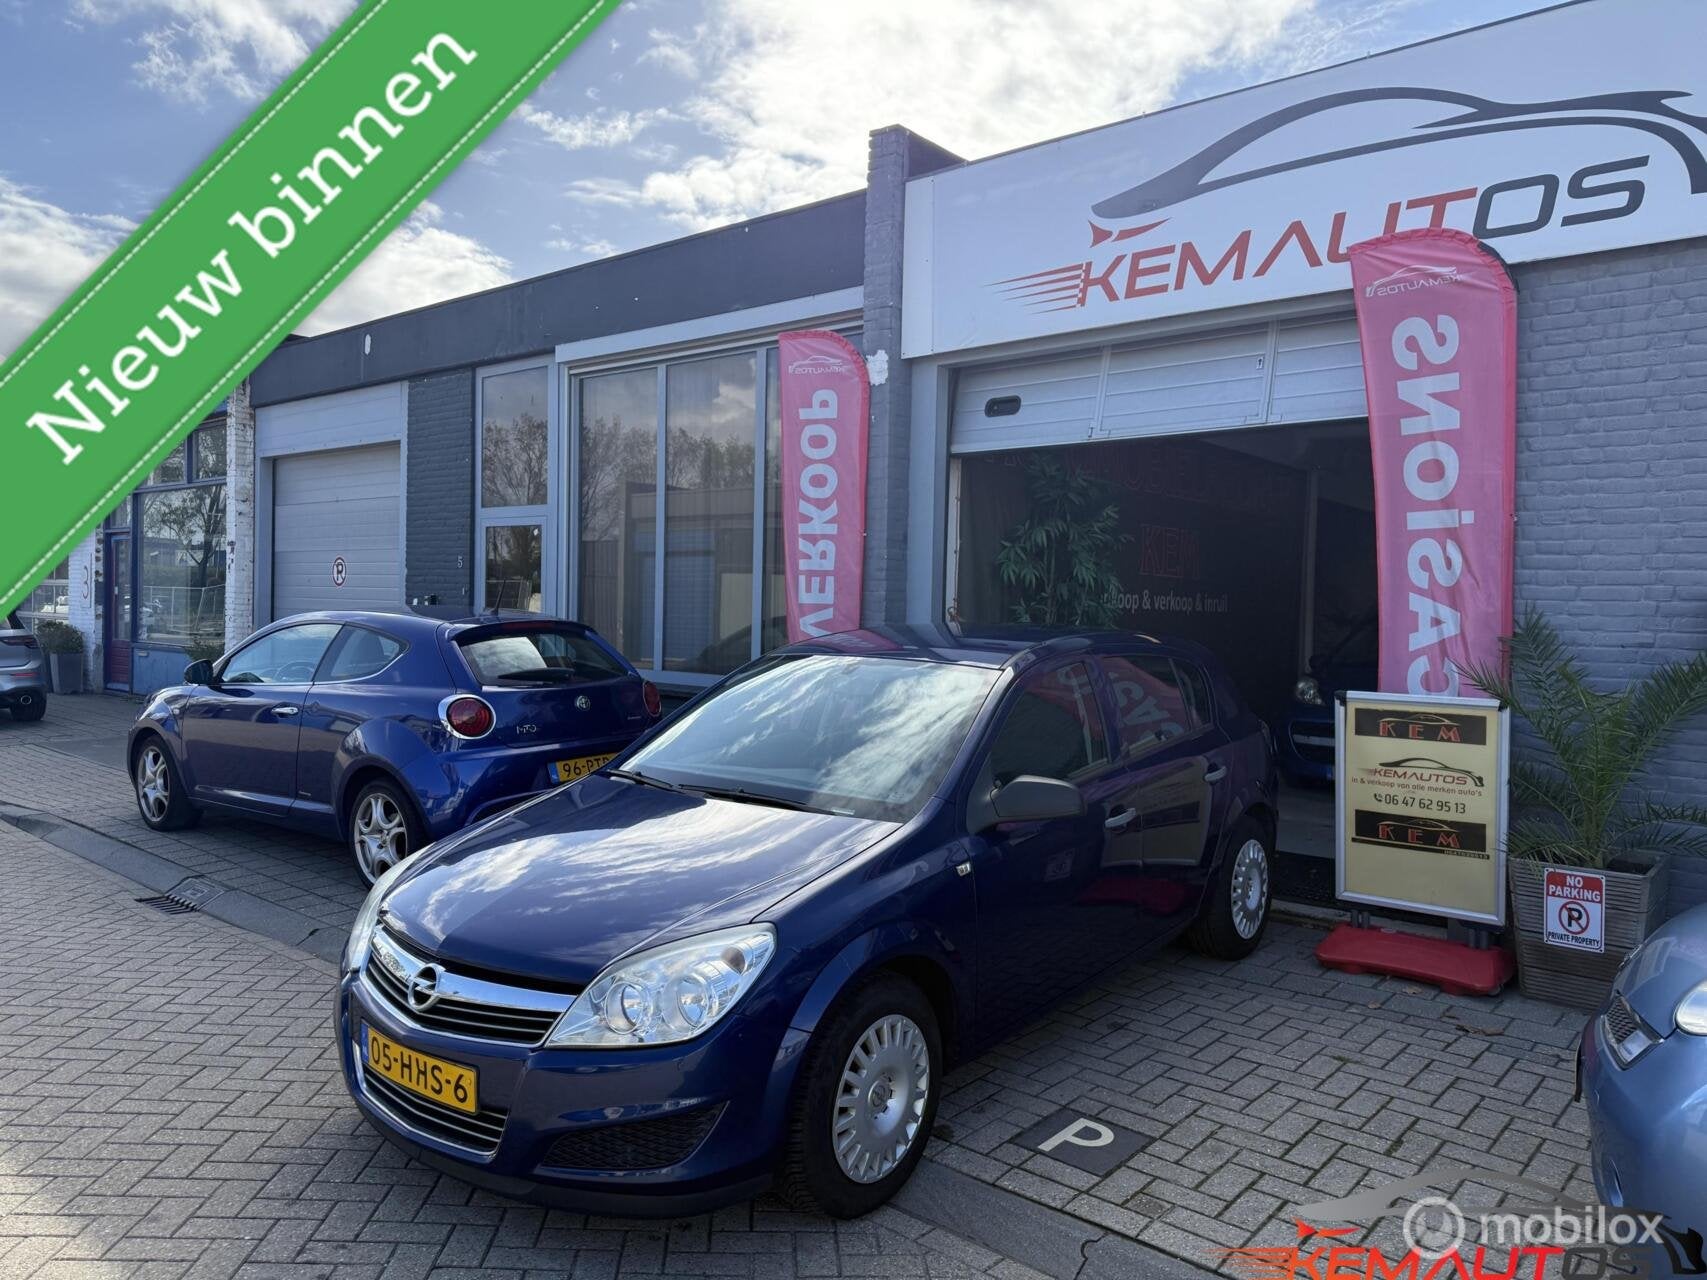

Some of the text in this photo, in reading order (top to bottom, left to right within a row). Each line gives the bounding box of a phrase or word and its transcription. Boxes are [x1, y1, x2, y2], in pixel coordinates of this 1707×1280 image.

[1077, 154, 1651, 307] KEMAUTOS
[457, 555, 463, 568] 5
[1142, 590, 1151, 610] &
[1153, 590, 1193, 615] verkoop
[1379, 721, 1461, 743] KEM
[1367, 778, 1395, 789] verkoop
[1427, 785, 1456, 795] merken
[1457, 788, 1482, 797] auto's
[1373, 768, 1468, 786] KEMAUTOS
[1384, 793, 1467, 814] 06 47 62 95 13
[1378, 823, 1461, 849] KEM
[1566, 875, 1584, 888] NO
[1548, 885, 1601, 902] PARKING
[1548, 931, 1600, 947] PRIVATE PROPERTY
[371, 1036, 468, 1103] 05-HHS-6
[1037, 1117, 1115, 1152] P
